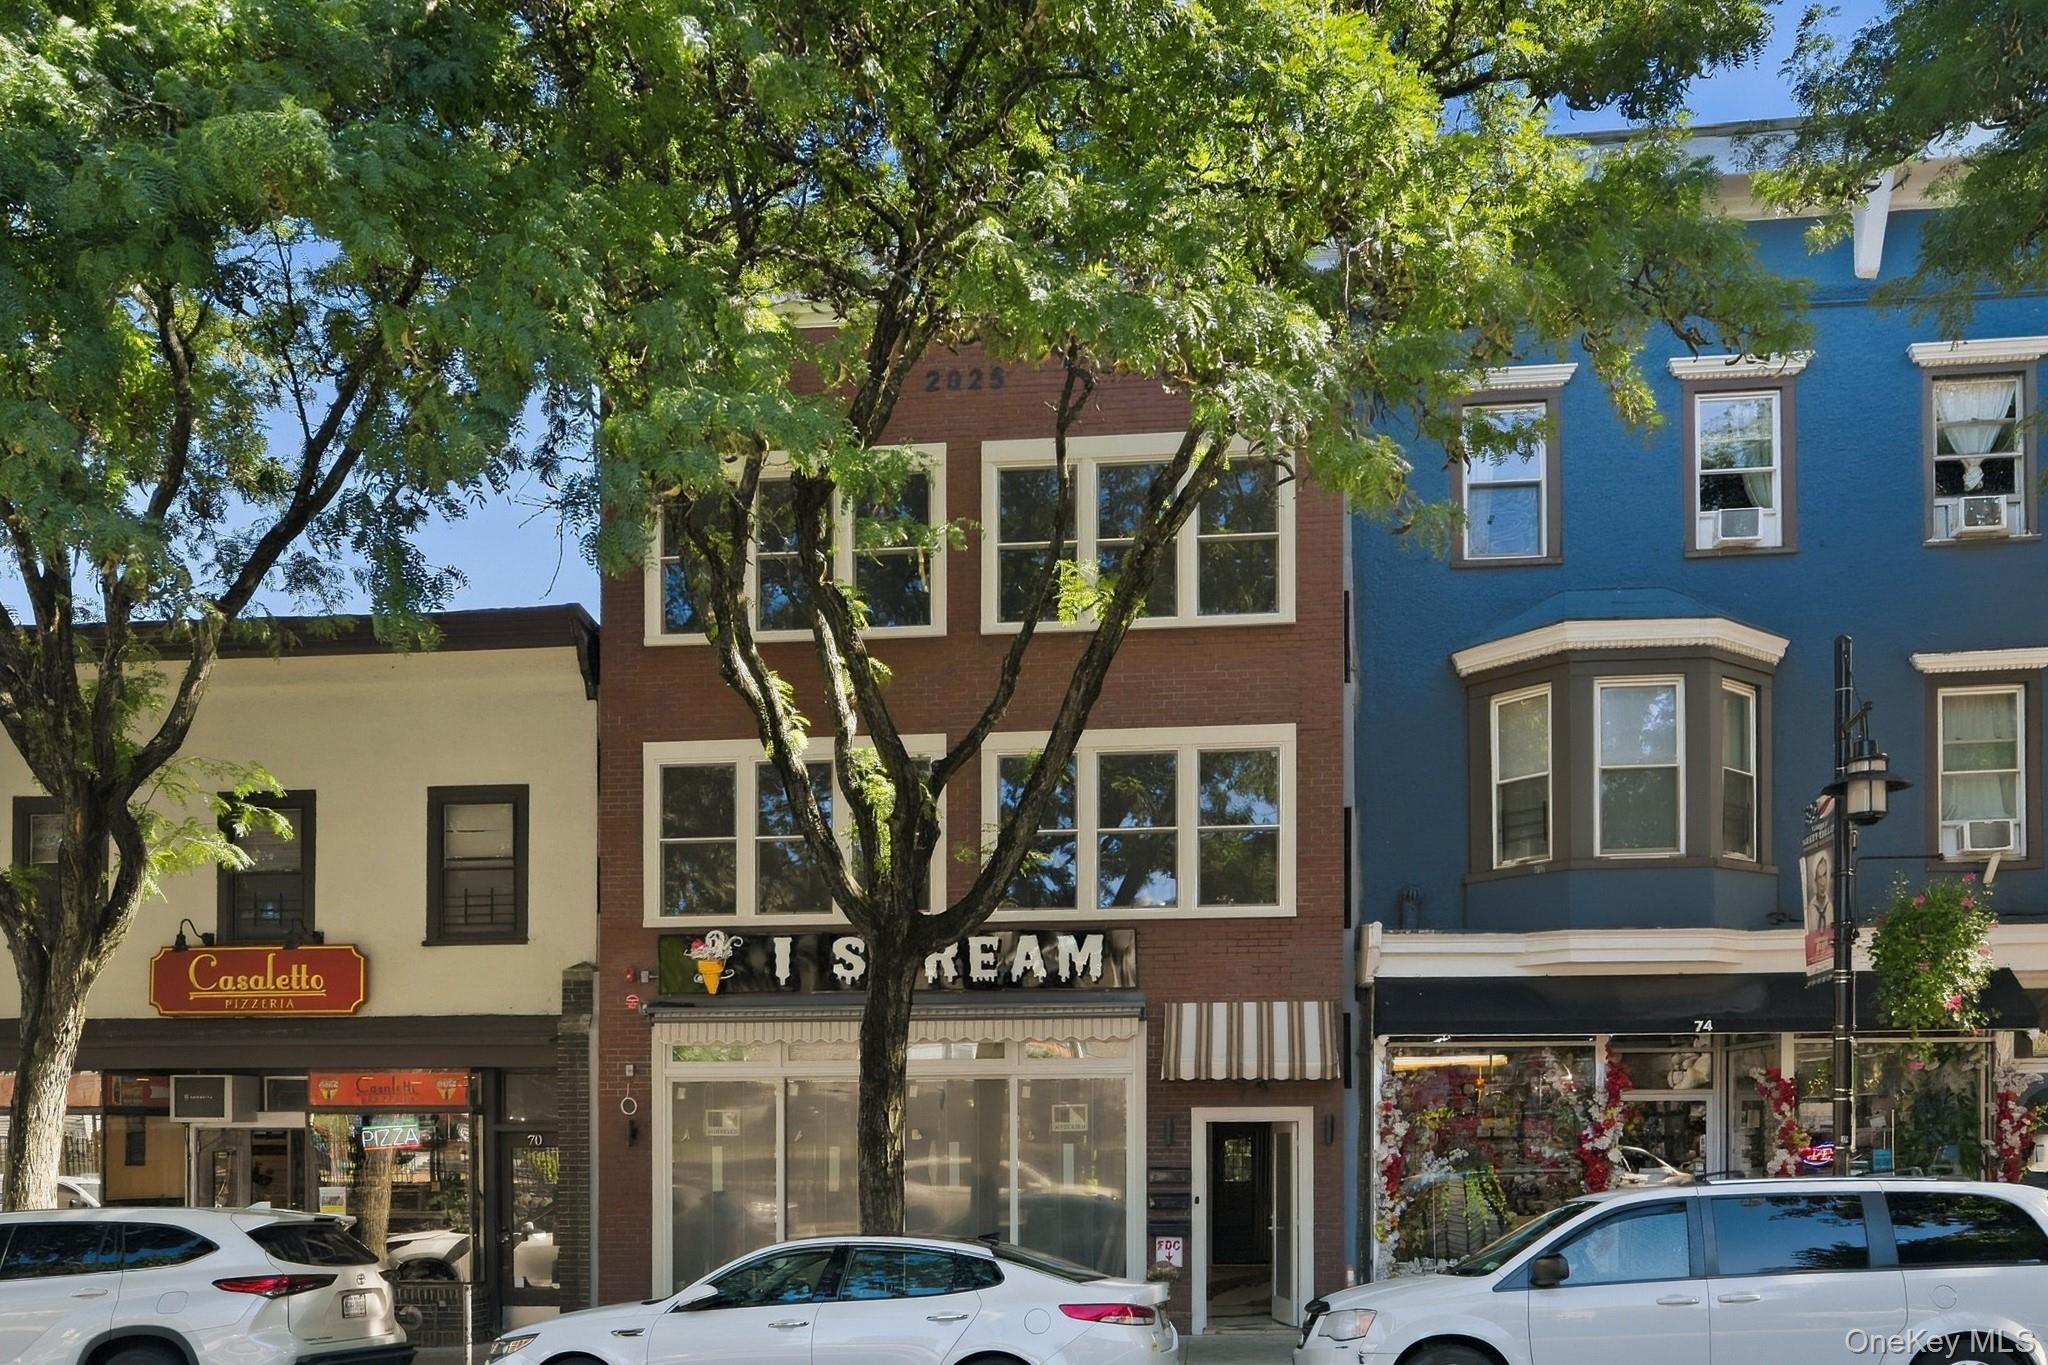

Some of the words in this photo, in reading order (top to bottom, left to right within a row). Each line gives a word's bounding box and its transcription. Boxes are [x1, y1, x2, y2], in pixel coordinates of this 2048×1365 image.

[773, 936, 792, 985] I
[832, 934, 1104, 985] SREAM
[188, 953, 324, 990] Casaletto
[225, 999, 295, 1009] PIZZERIA
[1694, 1019, 1713, 1032] 74
[361, 1127, 420, 1148] PIZZA
[527, 1134, 543, 1146] 70
[1157, 1240, 1181, 1251] FDC
